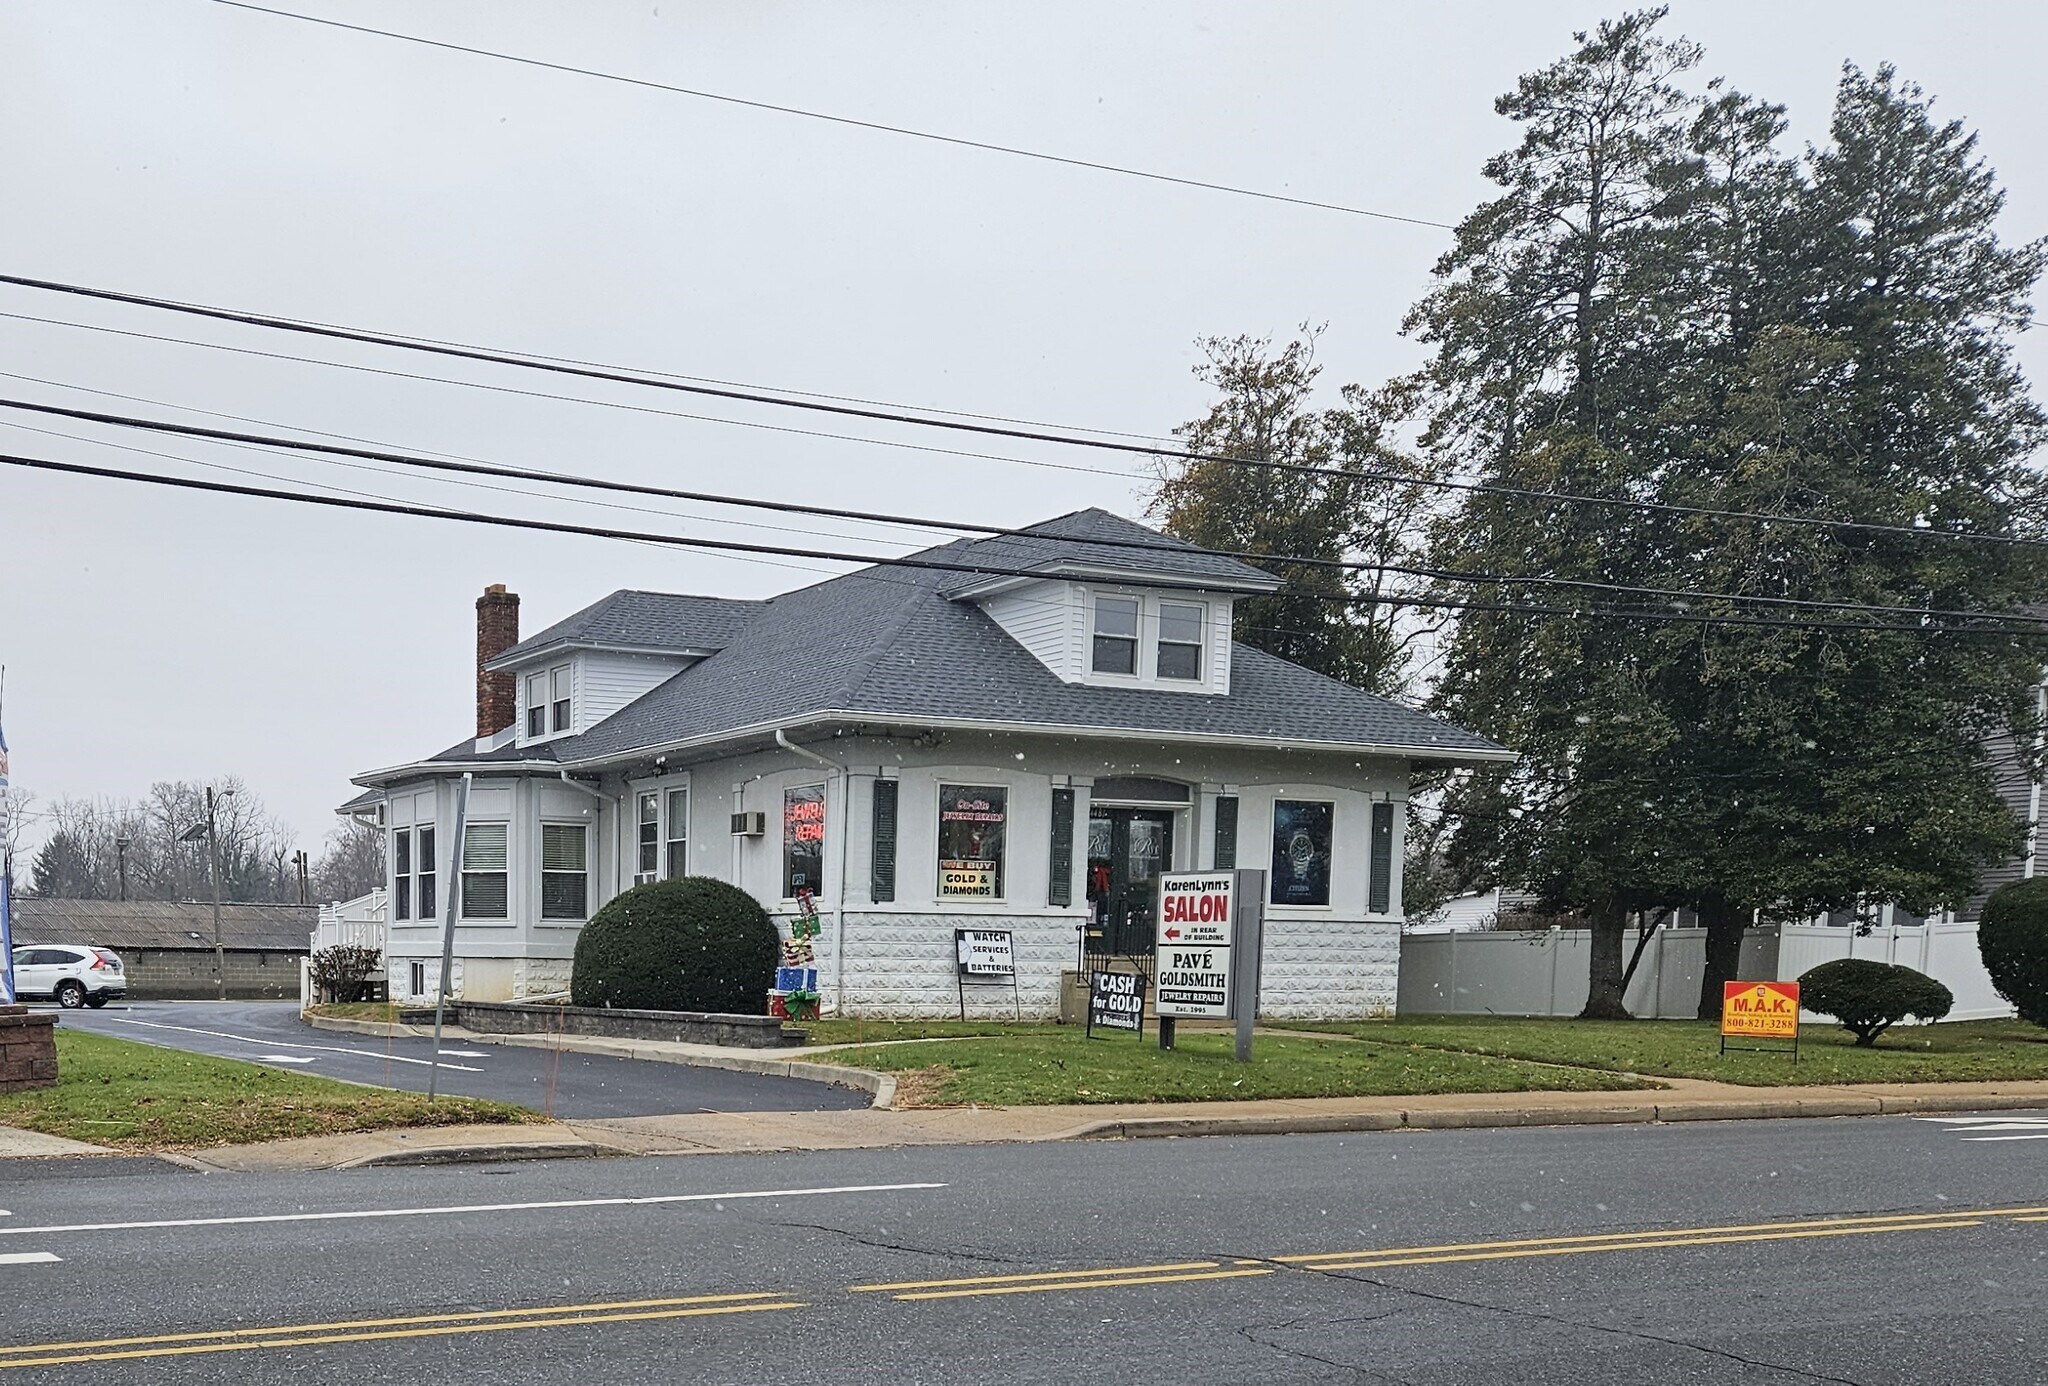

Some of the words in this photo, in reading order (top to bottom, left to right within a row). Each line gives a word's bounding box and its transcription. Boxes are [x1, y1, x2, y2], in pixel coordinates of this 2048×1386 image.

[946, 874, 976, 883] GOLD
[980, 875, 988, 884] &
[943, 886, 990, 895] DIAMONDS
[1164, 880, 1230, 892] KarenLynn's
[1164, 895, 1228, 923] SALON
[973, 932, 1006, 942] WATCH
[973, 946, 1009, 954] SERVICES
[1173, 949, 1212, 969] PAVÉ
[971, 964, 1014, 972] BATTERIES
[1100, 974, 1135, 994] CASH
[1160, 971, 1226, 988] GOLDSMITH
[1093, 995, 1106, 1009] for
[1109, 994, 1141, 1012] GOLD
[1161, 991, 1192, 1001] JEWELRY
[1193, 993, 1223, 1004] REPAIRS
[1734, 999, 1791, 1013] M.A.K.
[1095, 1014, 1101, 1023] &
[1102, 1015, 1134, 1028] Diamonds
[1727, 1019, 1794, 1029] 800-821-3288
